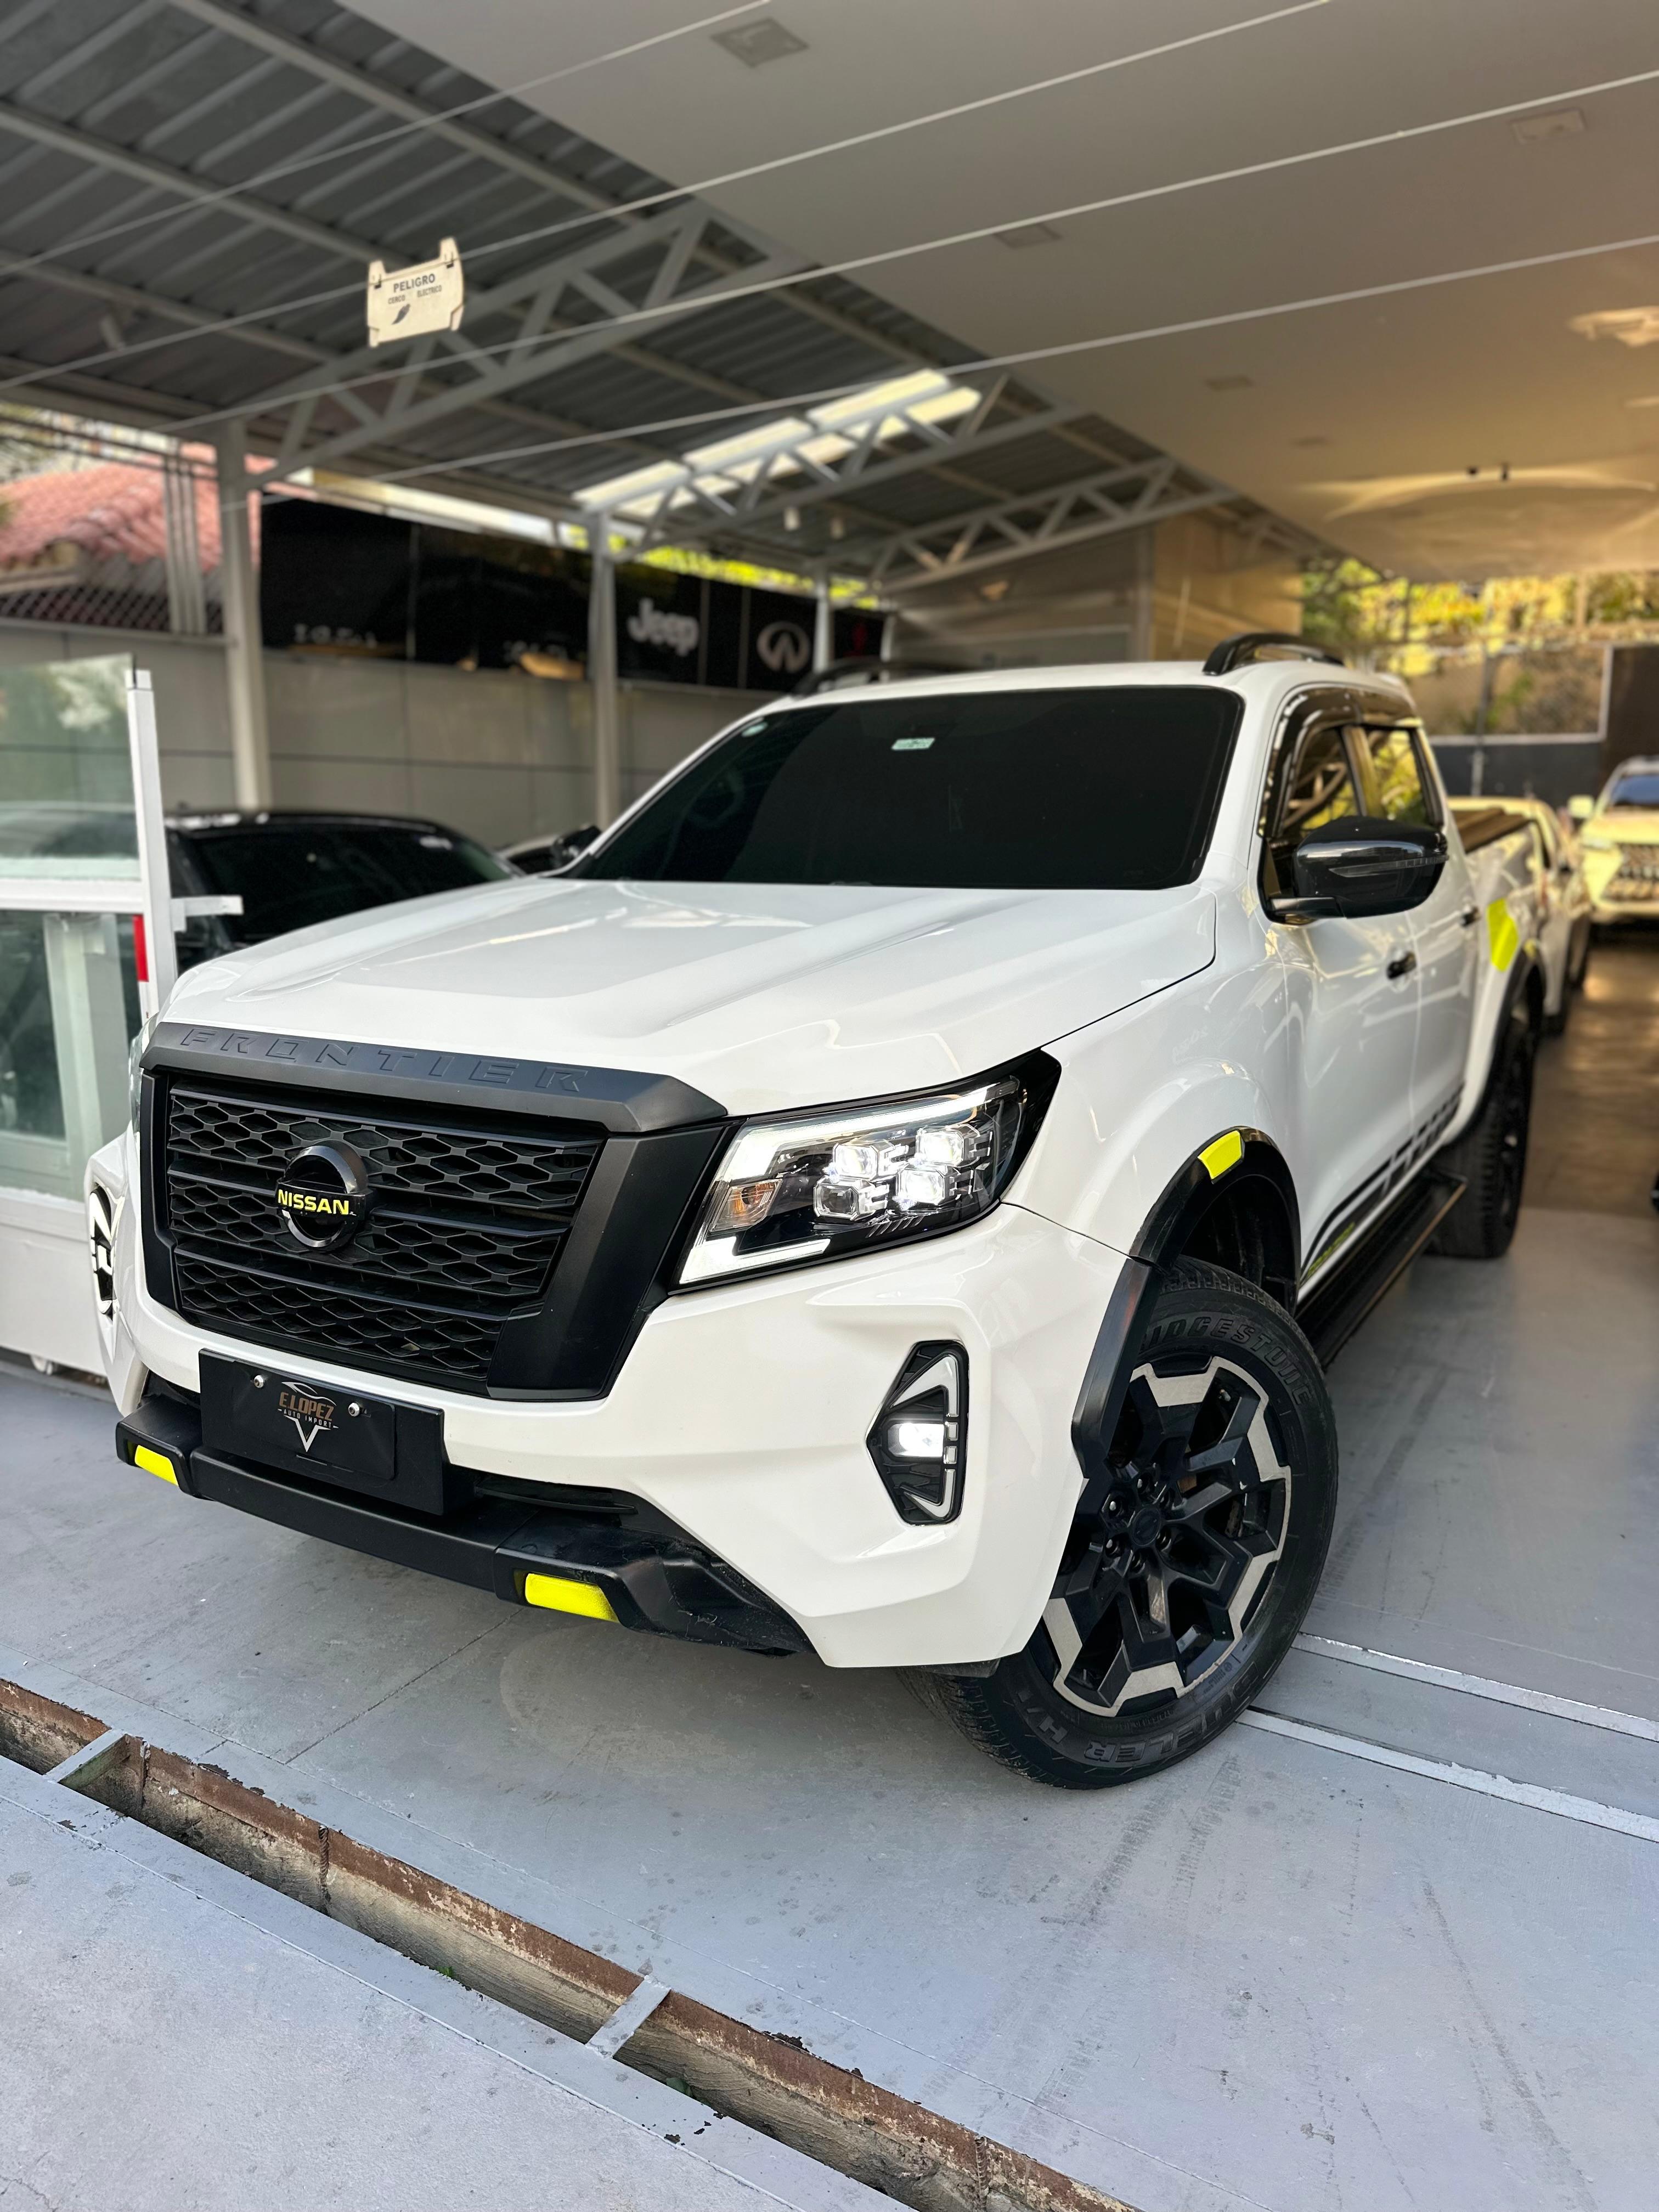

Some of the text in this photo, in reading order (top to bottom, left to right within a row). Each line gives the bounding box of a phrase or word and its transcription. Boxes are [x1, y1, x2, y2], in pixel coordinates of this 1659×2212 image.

[388, 285, 442, 304] CERCO ELECTRICO
[393, 274, 435, 293] PELIGRO
[628, 598, 699, 657] Jeep
[180, 1027, 589, 1092] FRONTIER
[278, 1189, 349, 1216] NISSAN
[1141, 1316, 1314, 1406] IDGESTONE
[284, 1409, 331, 1428] AUTO IMPORT
